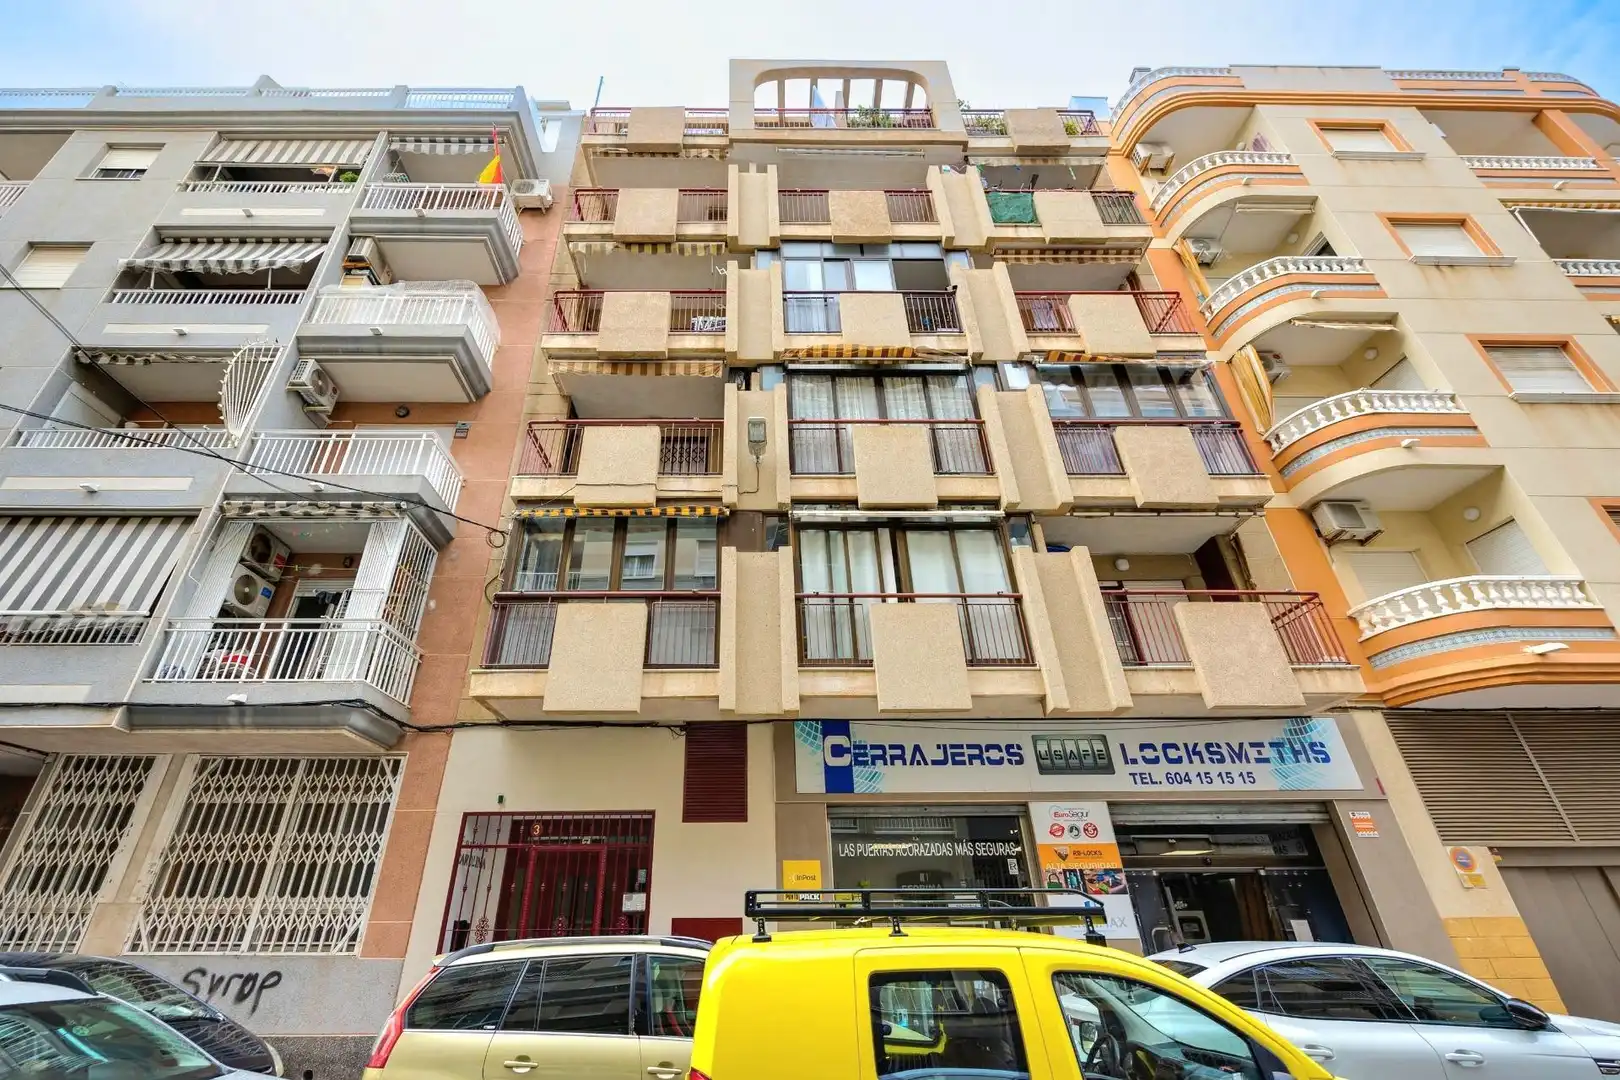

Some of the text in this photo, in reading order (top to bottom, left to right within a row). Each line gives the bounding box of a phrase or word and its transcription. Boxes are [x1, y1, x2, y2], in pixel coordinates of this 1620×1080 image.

[823, 735, 1025, 767] CERRAJEROS
[1119, 741, 1331, 765] LOCKSMITHS
[1128, 771, 1256, 786] TEL. 604 15 15 15
[533, 825, 541, 835] 3
[838, 840, 1017, 857] LAS PUERTAS ACORAZADAS MÁS SEGURAS
[1069, 862, 1118, 870] SEGURIDAD
[799, 893, 820, 901] PACK
